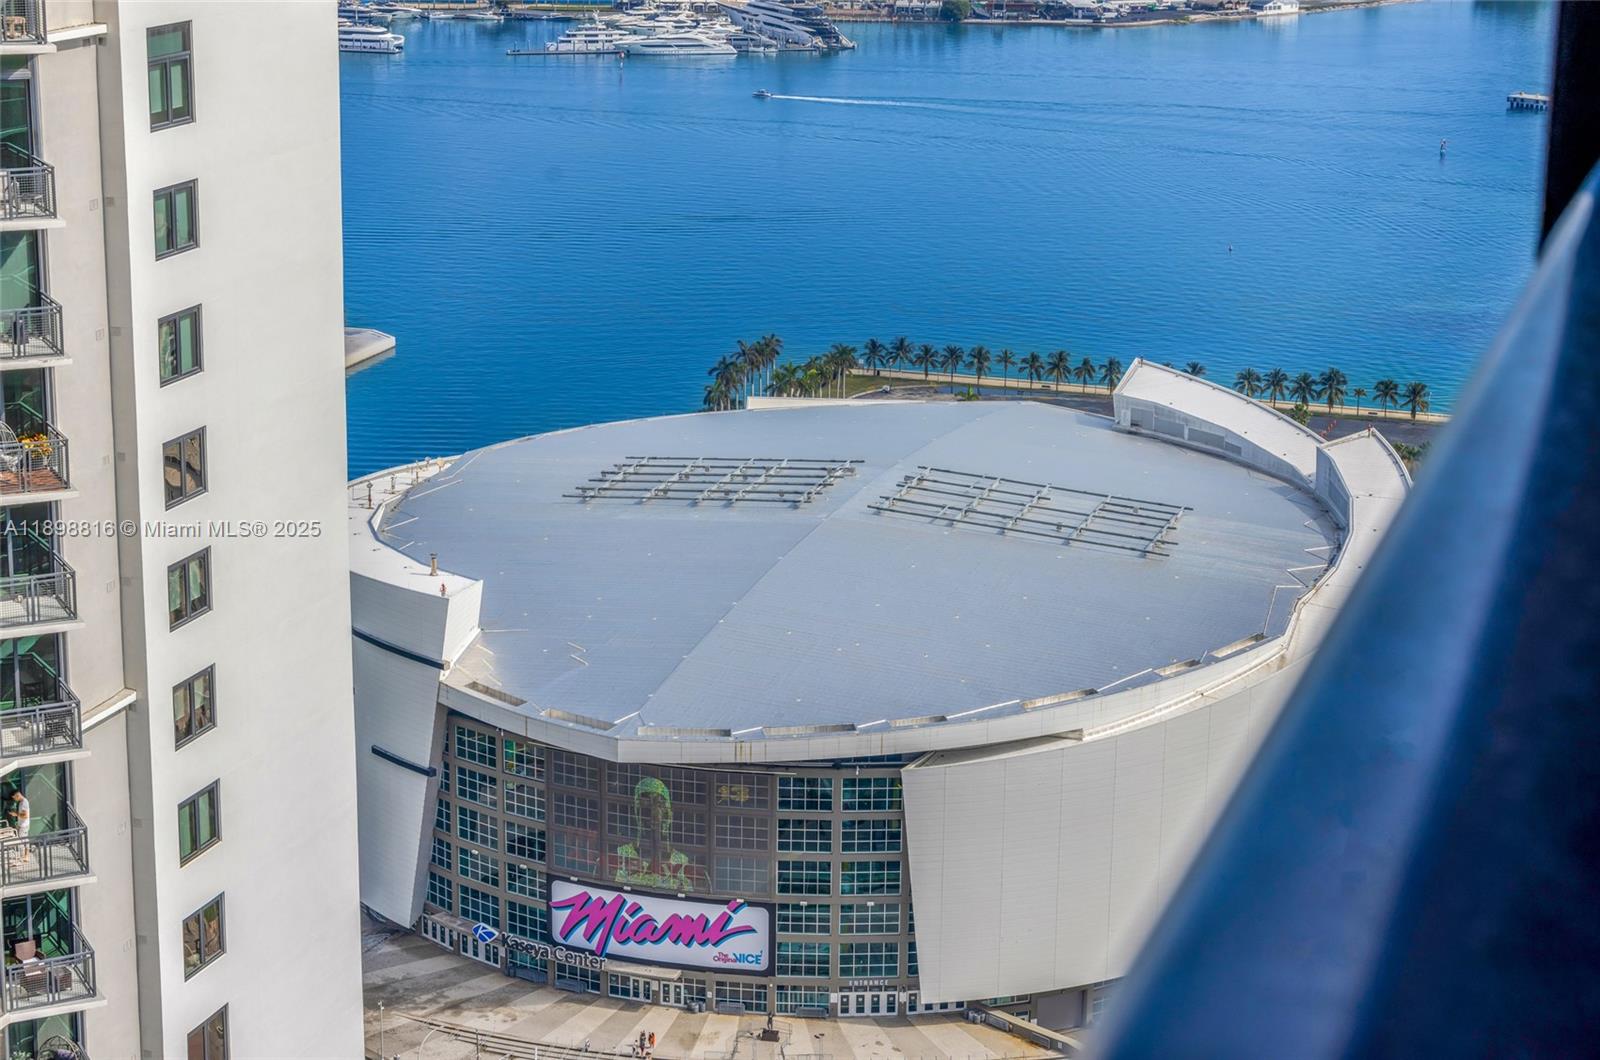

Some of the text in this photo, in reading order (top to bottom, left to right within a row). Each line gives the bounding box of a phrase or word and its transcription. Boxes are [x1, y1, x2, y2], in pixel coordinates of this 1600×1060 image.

[549, 891, 757, 957] Miami
[501, 932, 607, 970] Kaseya Center
